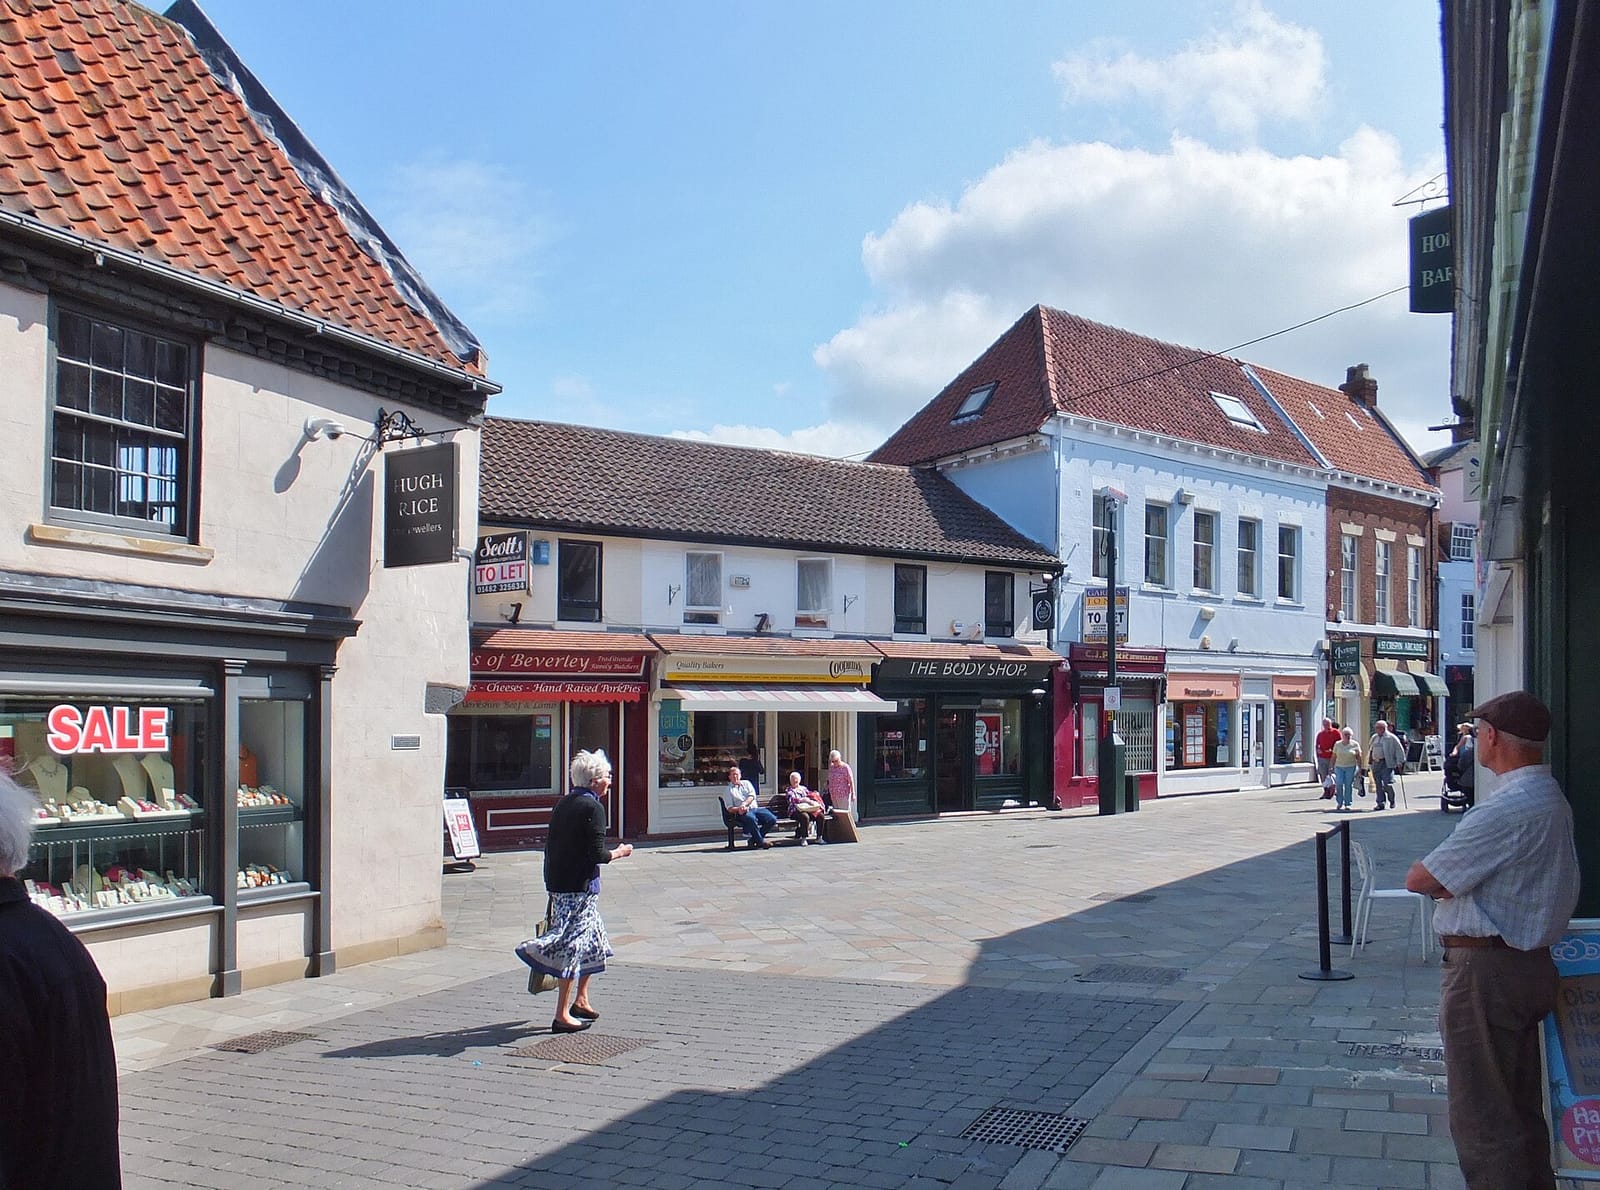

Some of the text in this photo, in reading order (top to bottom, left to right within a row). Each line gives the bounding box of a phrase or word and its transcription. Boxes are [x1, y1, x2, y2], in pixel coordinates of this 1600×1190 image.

[393, 473, 443, 494] HUGH
[399, 498, 439, 516] RICE
[479, 536, 523, 558] Scotts
[477, 563, 525, 582] TO LET
[1088, 612, 1101, 623] TO
[487, 653, 505, 671] of
[511, 653, 590, 673] Beverley
[676, 660, 701, 670] Quality
[910, 661, 938, 675] THE
[942, 662, 987, 676] BODY
[486, 682, 524, 693] Cheeses
[532, 684, 564, 693] Hand
[565, 684, 599, 693] Raised
[47, 704, 169, 754] SALE
